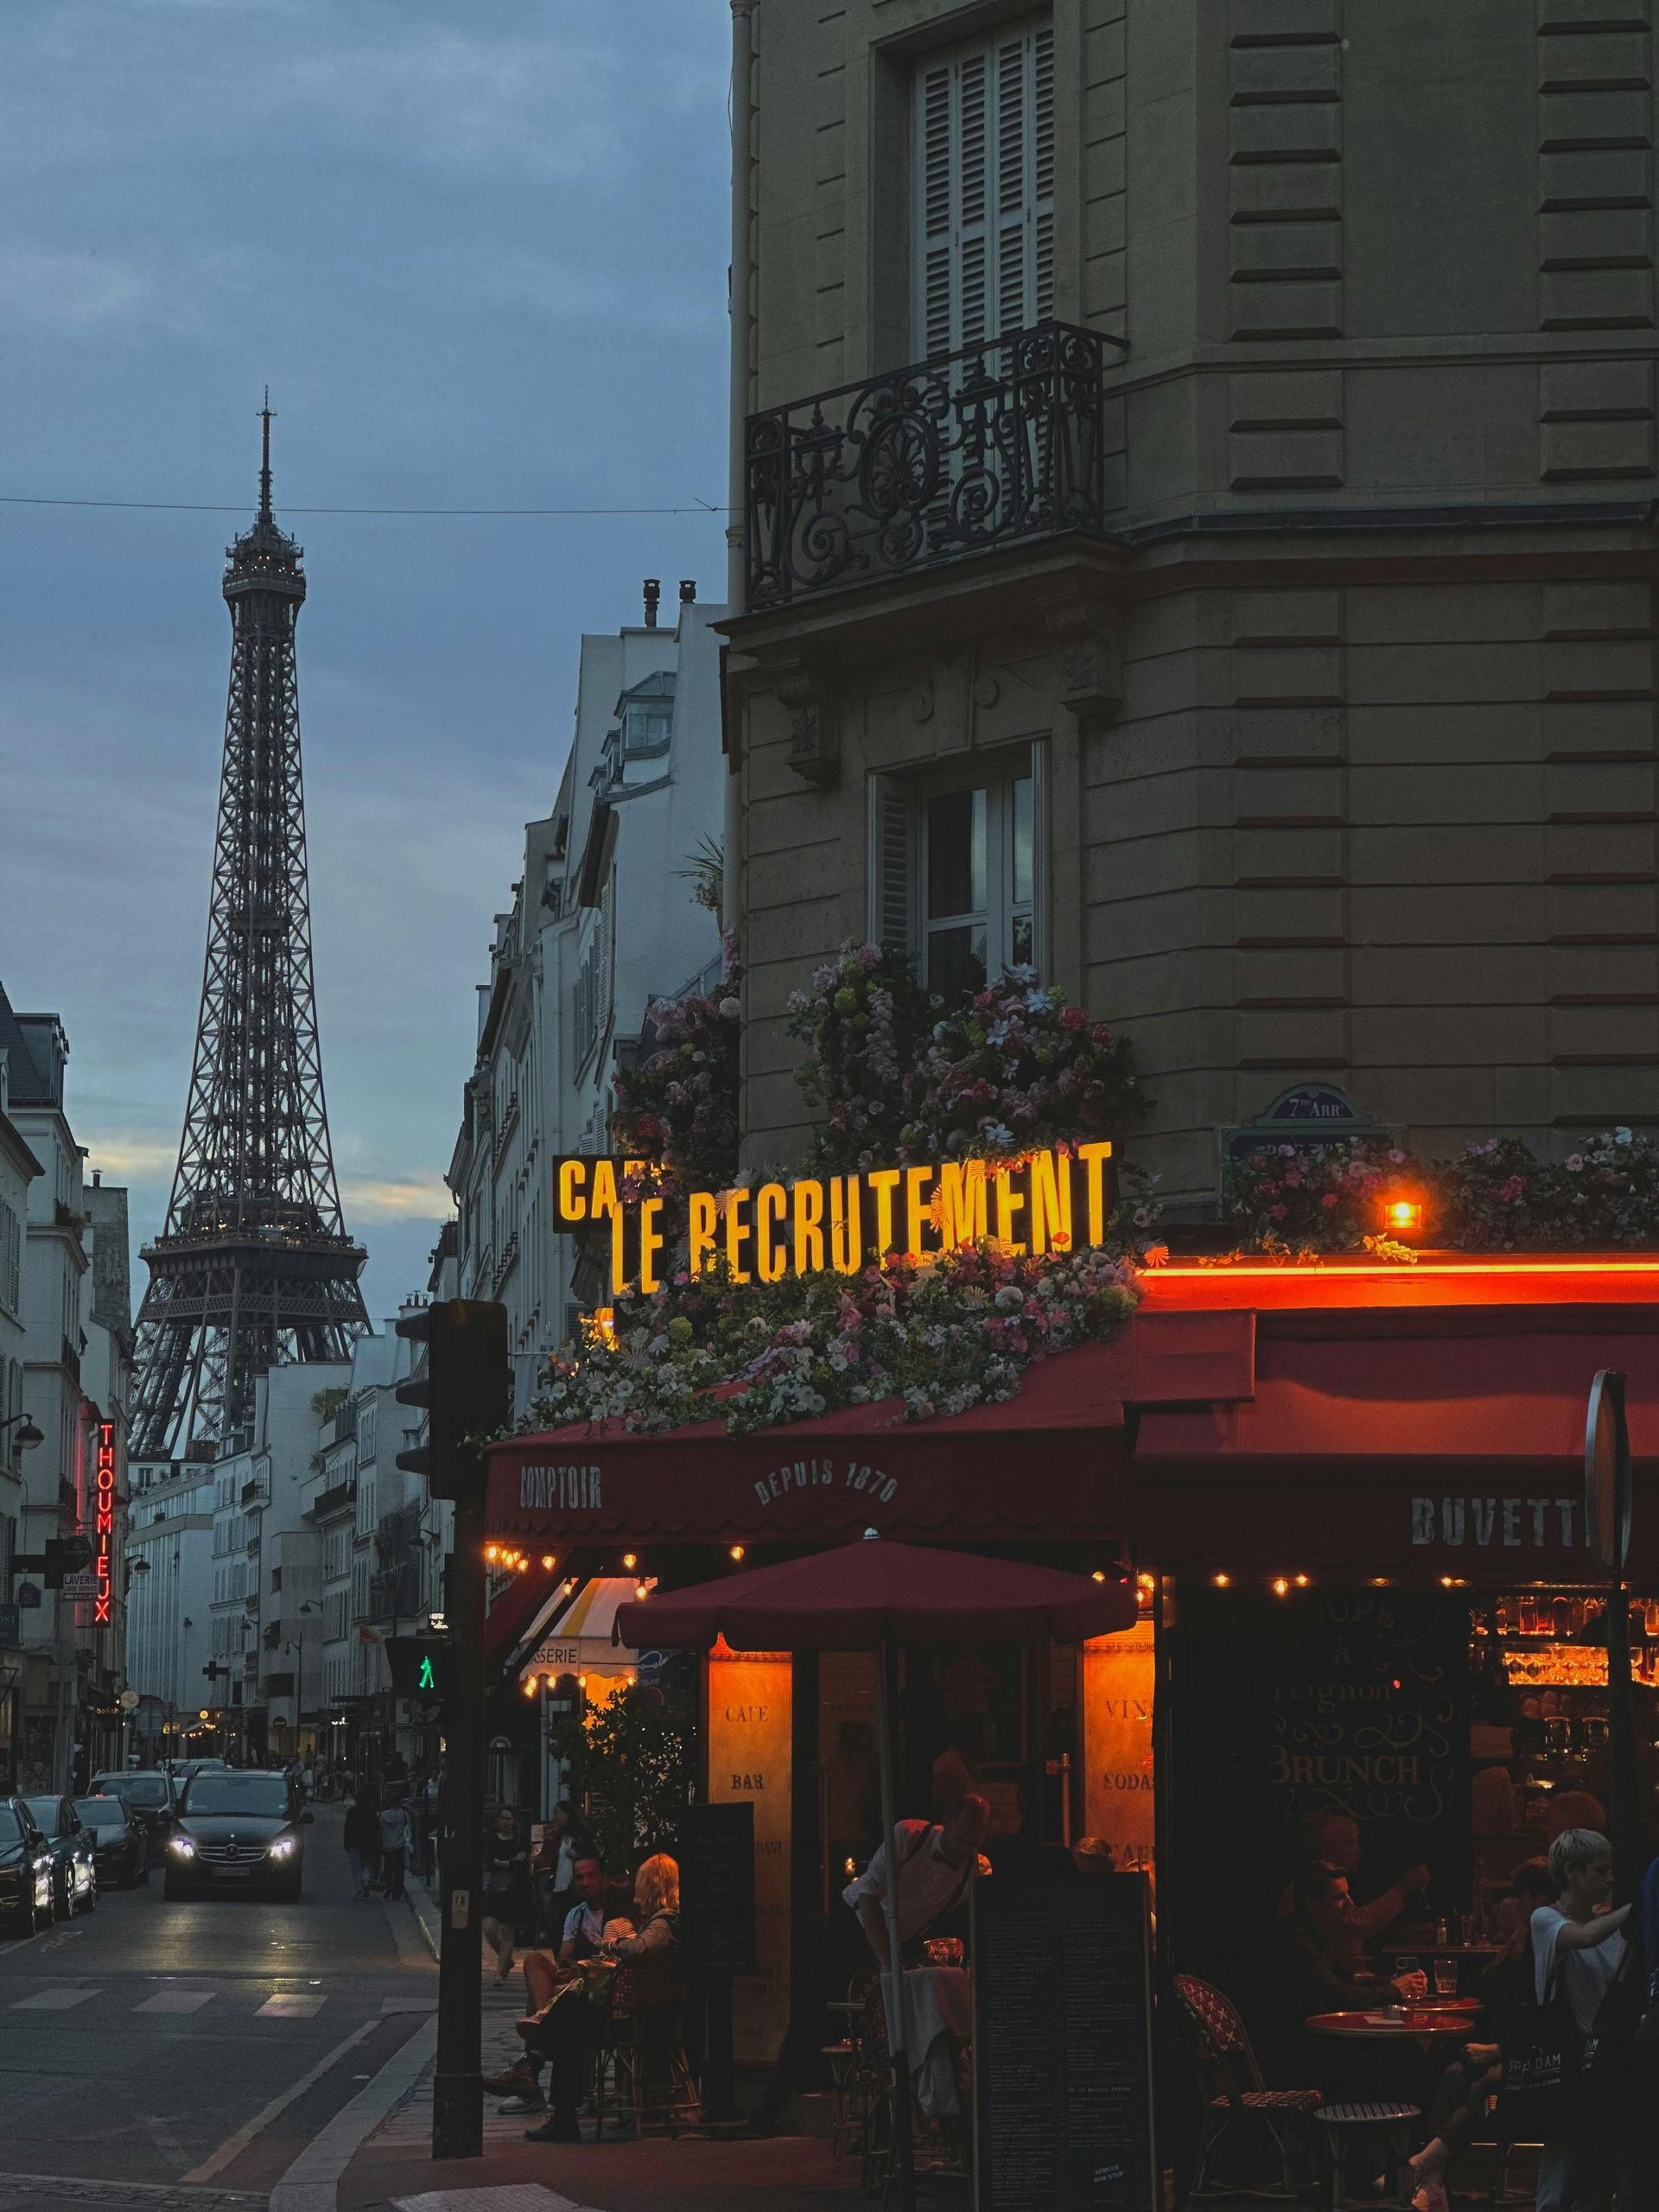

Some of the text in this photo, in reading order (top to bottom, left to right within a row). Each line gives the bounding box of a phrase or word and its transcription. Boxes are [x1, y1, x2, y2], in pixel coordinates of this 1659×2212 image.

[560, 1160, 664, 1220] CA
[612, 1141, 1113, 1295] LE RECRUTEMENT
[520, 1465, 602, 1509] COMPTOIR
[753, 1459, 899, 1506] DEPUIS 1870
[1410, 1496, 1592, 1548] BUVETT
[64, 1575, 98, 1585] LAVERIE
[1106, 1700, 1154, 1719] VIN
[731, 1774, 765, 1789] BAR
[1103, 1774, 1155, 1790] SODA
